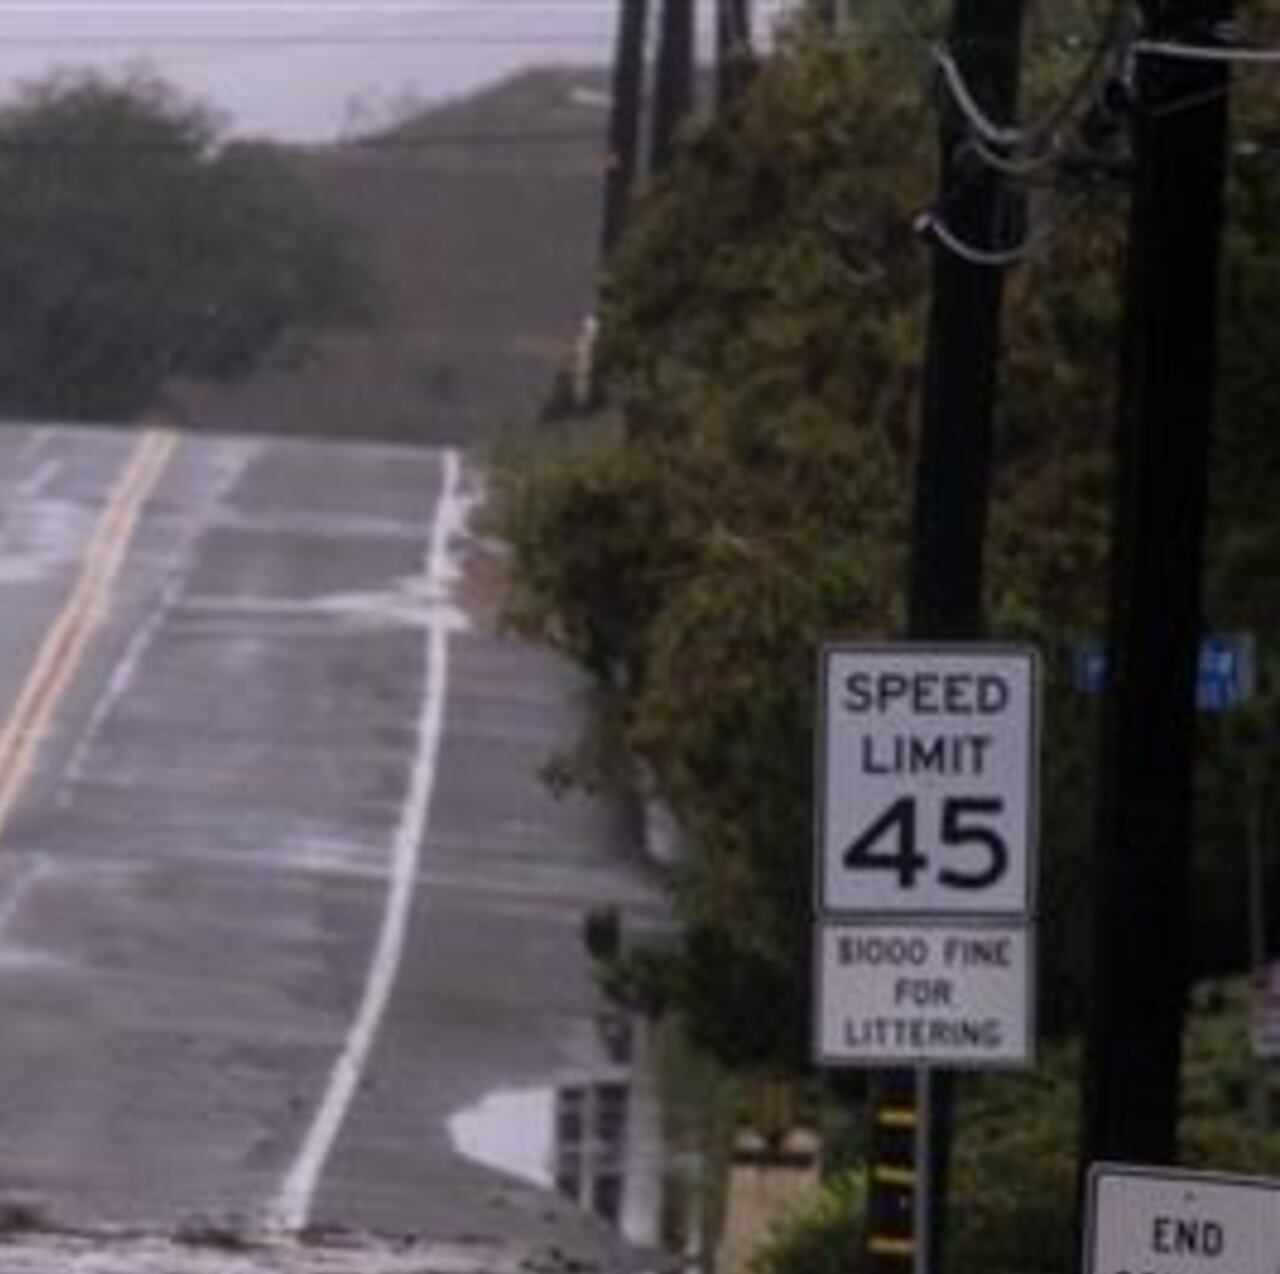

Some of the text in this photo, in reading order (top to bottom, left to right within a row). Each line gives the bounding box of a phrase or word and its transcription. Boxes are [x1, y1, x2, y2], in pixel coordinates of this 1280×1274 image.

[843, 672, 1010, 715] SPEED
[862, 736, 993, 775] LIMIT
[842, 796, 1010, 890] 45
[836, 937, 1012, 967] $1000 FINE
[894, 980, 953, 1005] FOR
[844, 1018, 1003, 1047] LITTERING
[1151, 1216, 1224, 1257] END
